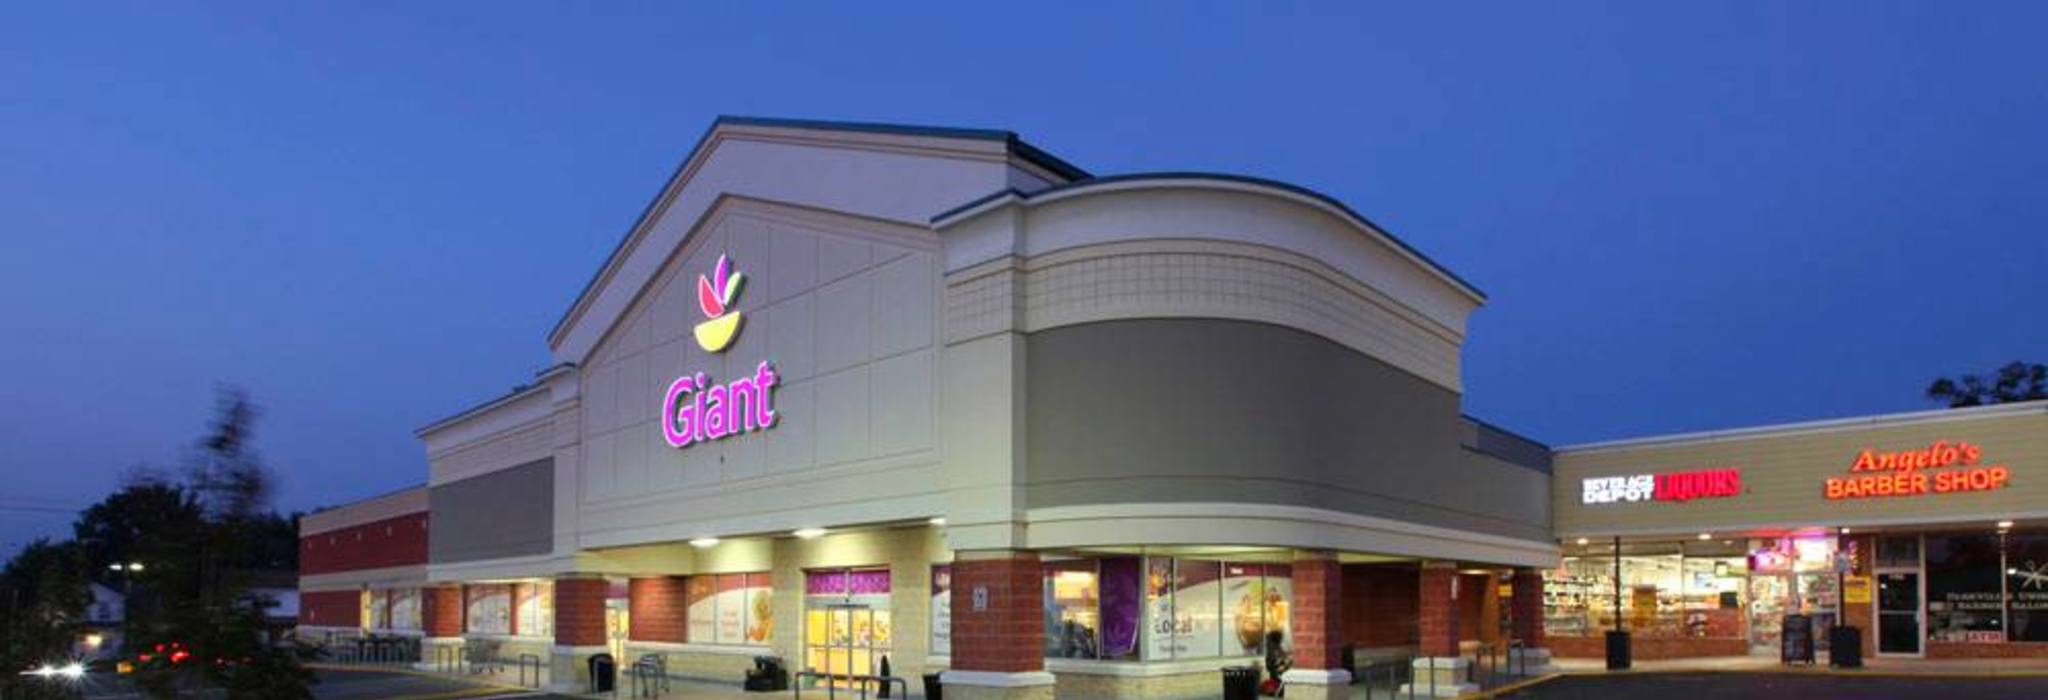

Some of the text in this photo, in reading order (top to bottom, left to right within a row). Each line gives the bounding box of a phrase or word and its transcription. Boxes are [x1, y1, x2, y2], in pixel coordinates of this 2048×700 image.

[662, 360, 776, 448] Giant
[1851, 440, 1980, 472] Angelo's
[1582, 474, 1655, 494] BEVERAGE
[1582, 487, 1653, 505] DEPOT
[1654, 468, 1741, 503] LIQUORS
[1825, 465, 2009, 500] BARBER SHOP
